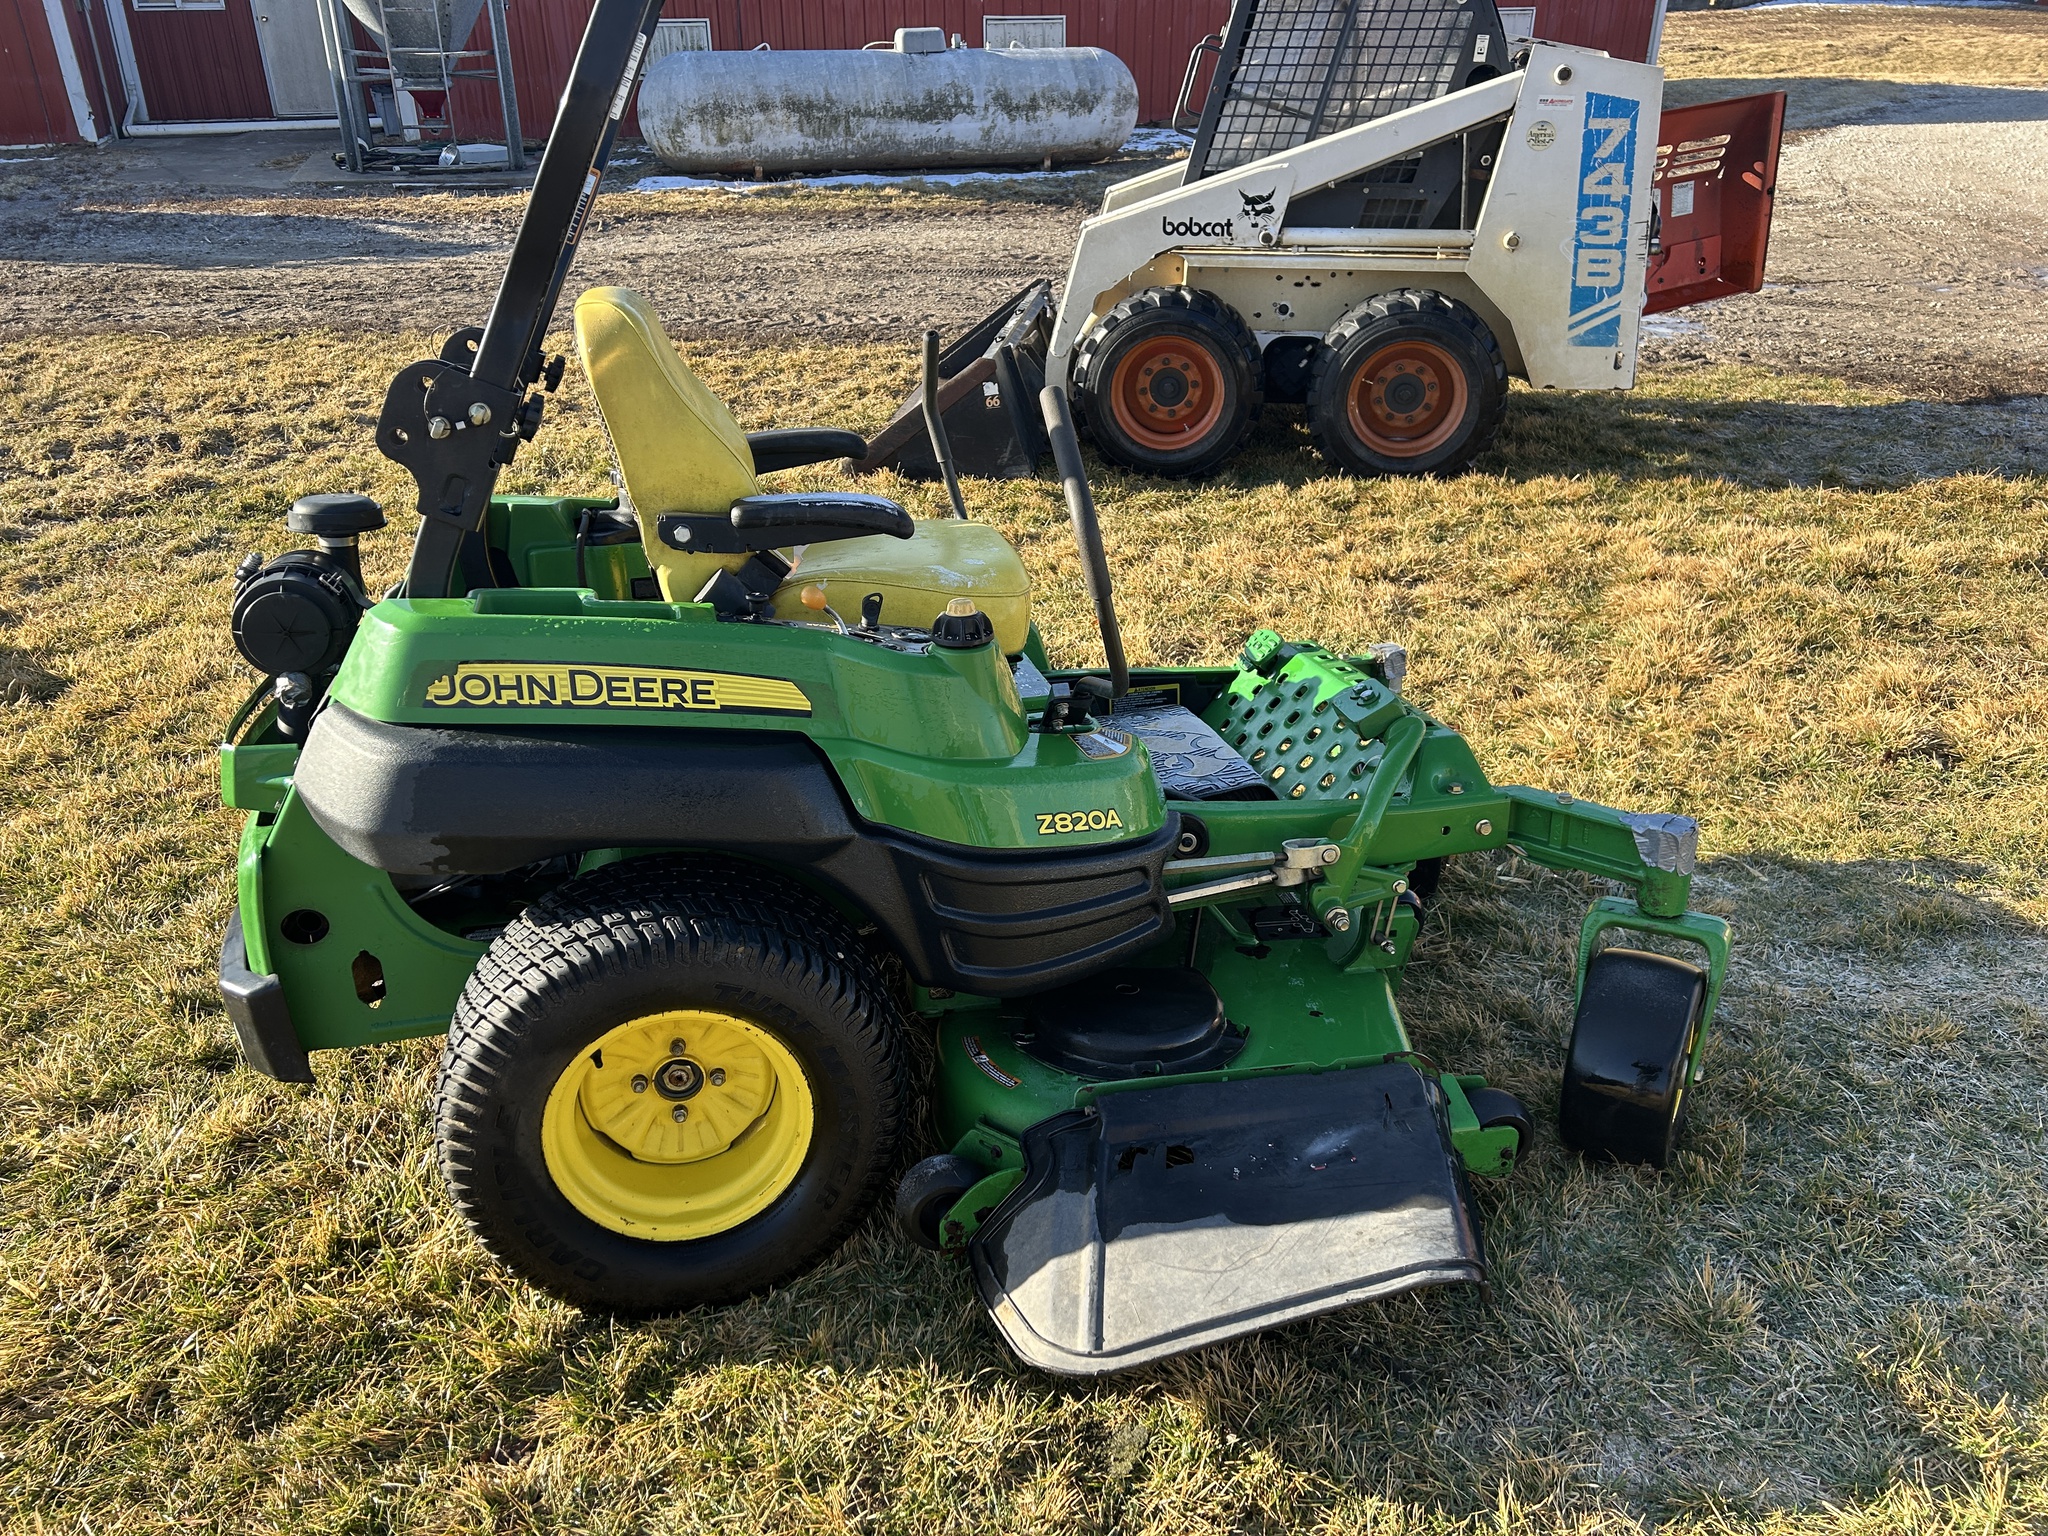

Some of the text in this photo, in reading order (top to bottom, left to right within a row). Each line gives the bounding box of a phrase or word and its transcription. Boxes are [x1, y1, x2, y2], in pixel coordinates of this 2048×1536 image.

[1576, 117, 1631, 288] 743B
[1162, 216, 1233, 237] bobcat
[985, 395, 1000, 408] 66
[431, 668, 720, 709] JOHN DEERE
[1035, 808, 1124, 835] Z820A
